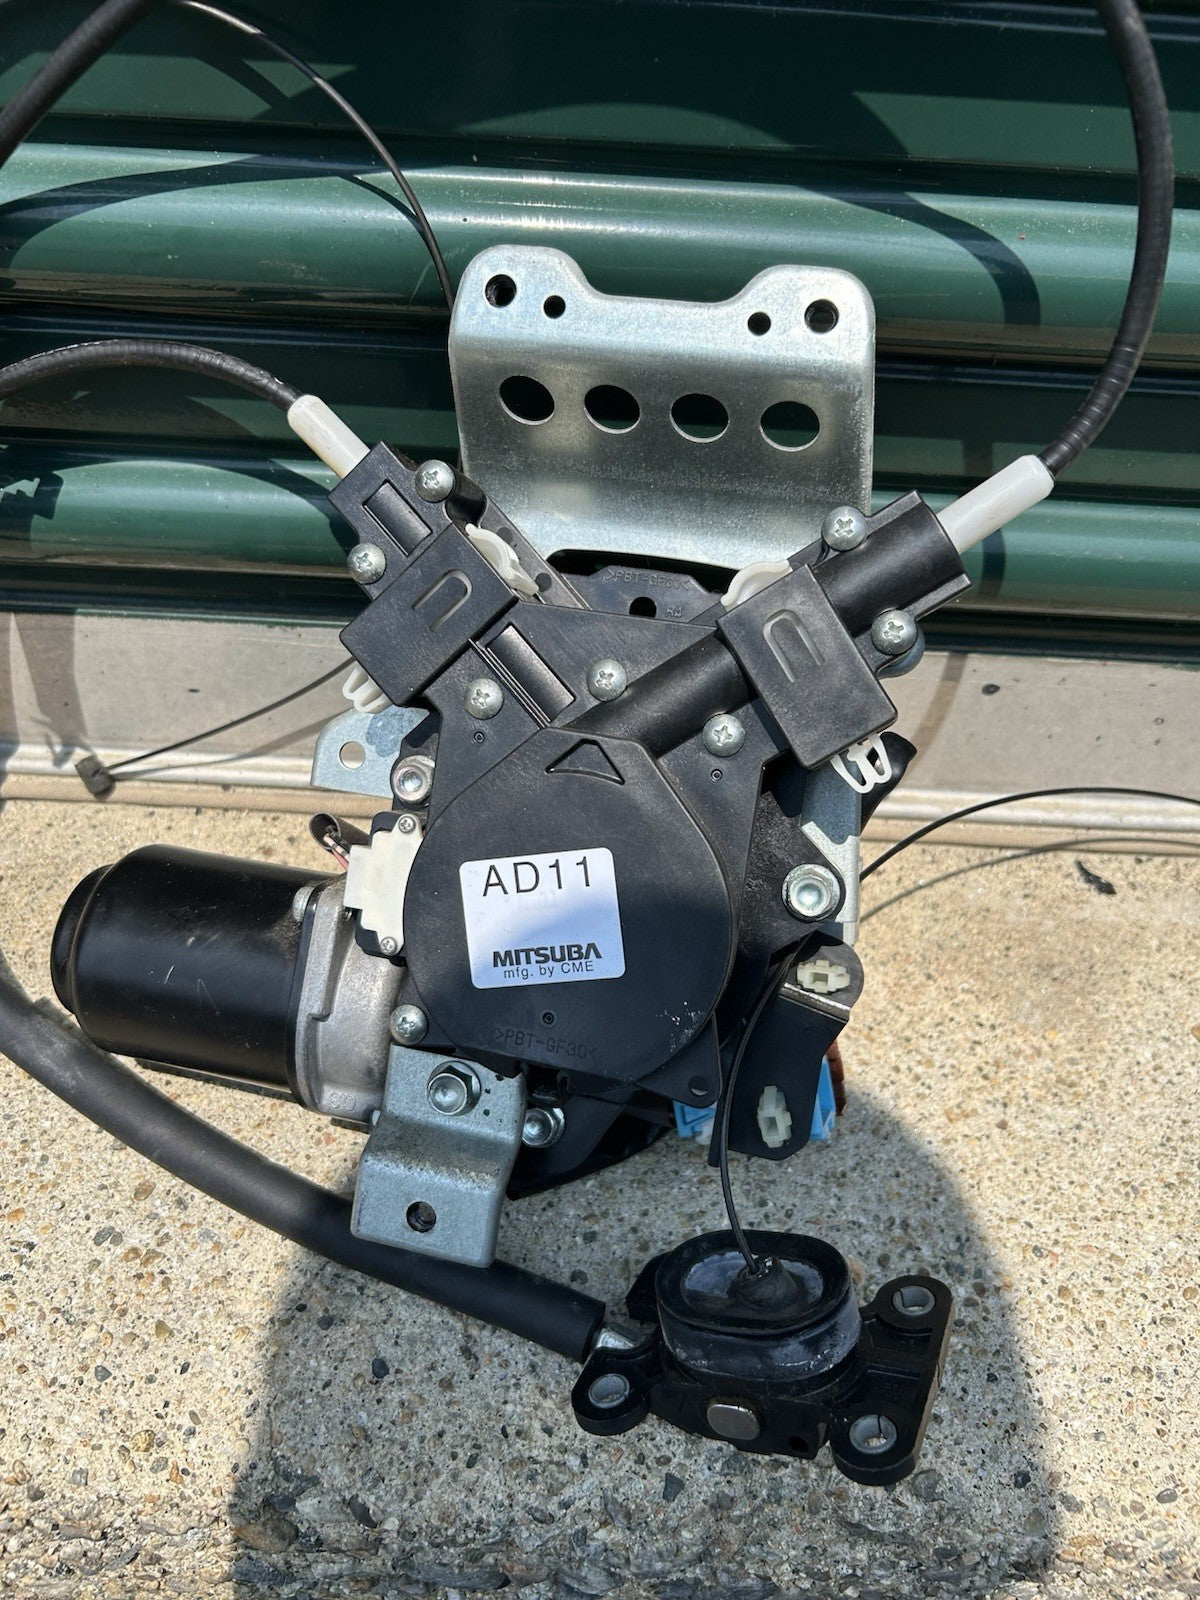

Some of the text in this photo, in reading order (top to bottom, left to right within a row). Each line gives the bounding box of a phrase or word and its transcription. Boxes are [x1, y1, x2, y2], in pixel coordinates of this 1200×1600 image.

[482, 856, 591, 897] AD11
[492, 942, 602, 968] MITSUBA
[503, 960, 595, 980] mfg. by CME
